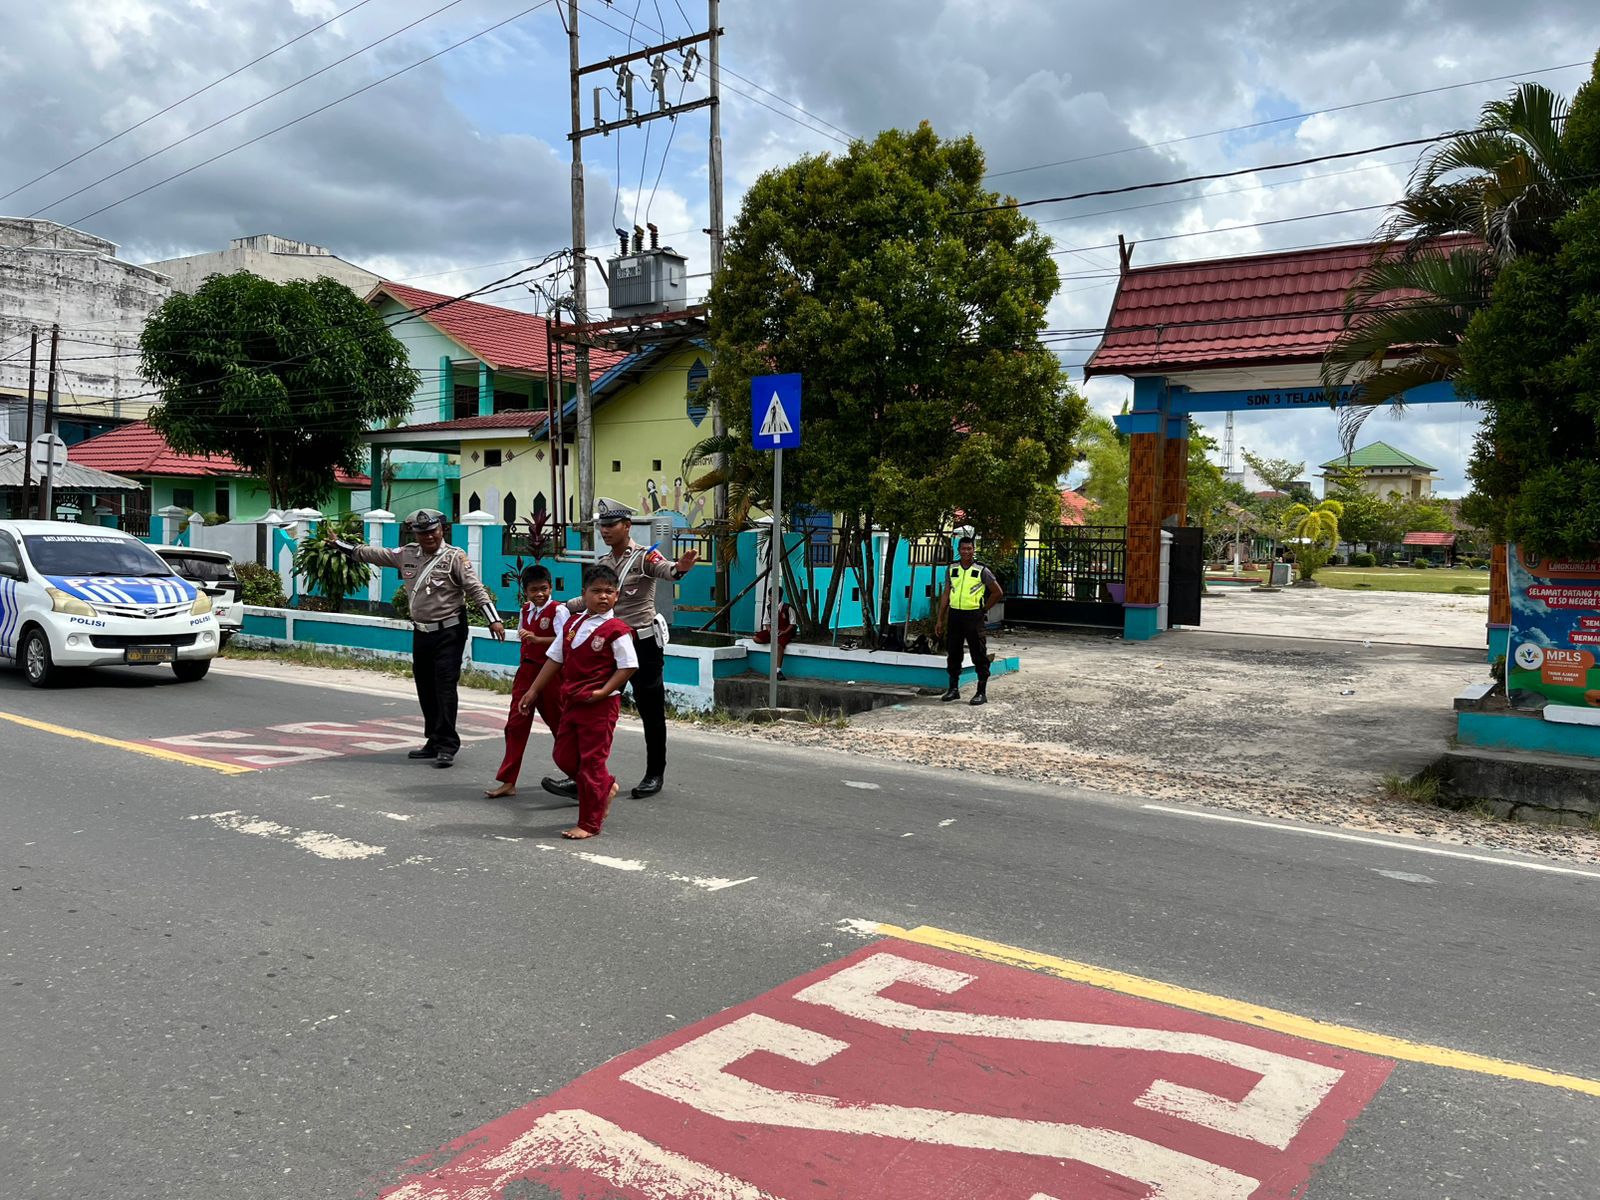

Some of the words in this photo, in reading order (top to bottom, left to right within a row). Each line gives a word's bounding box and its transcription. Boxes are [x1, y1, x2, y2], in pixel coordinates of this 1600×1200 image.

[1247, 395, 1269, 406] SDN
[1274, 394, 1281, 405] 3
[1285, 390, 1358, 404] TELANKA
[64, 577, 183, 588] POLISI
[1529, 588, 1561, 597] SELAMAT
[1562, 589, 1592, 598] DATANG
[1568, 598, 1596, 606] NEGERI
[70, 616, 106, 628] POLISI
[190, 615, 211, 626] POLISI
[1583, 619, 1600, 627] "SEM
[1547, 650, 1582, 662] MPLS
